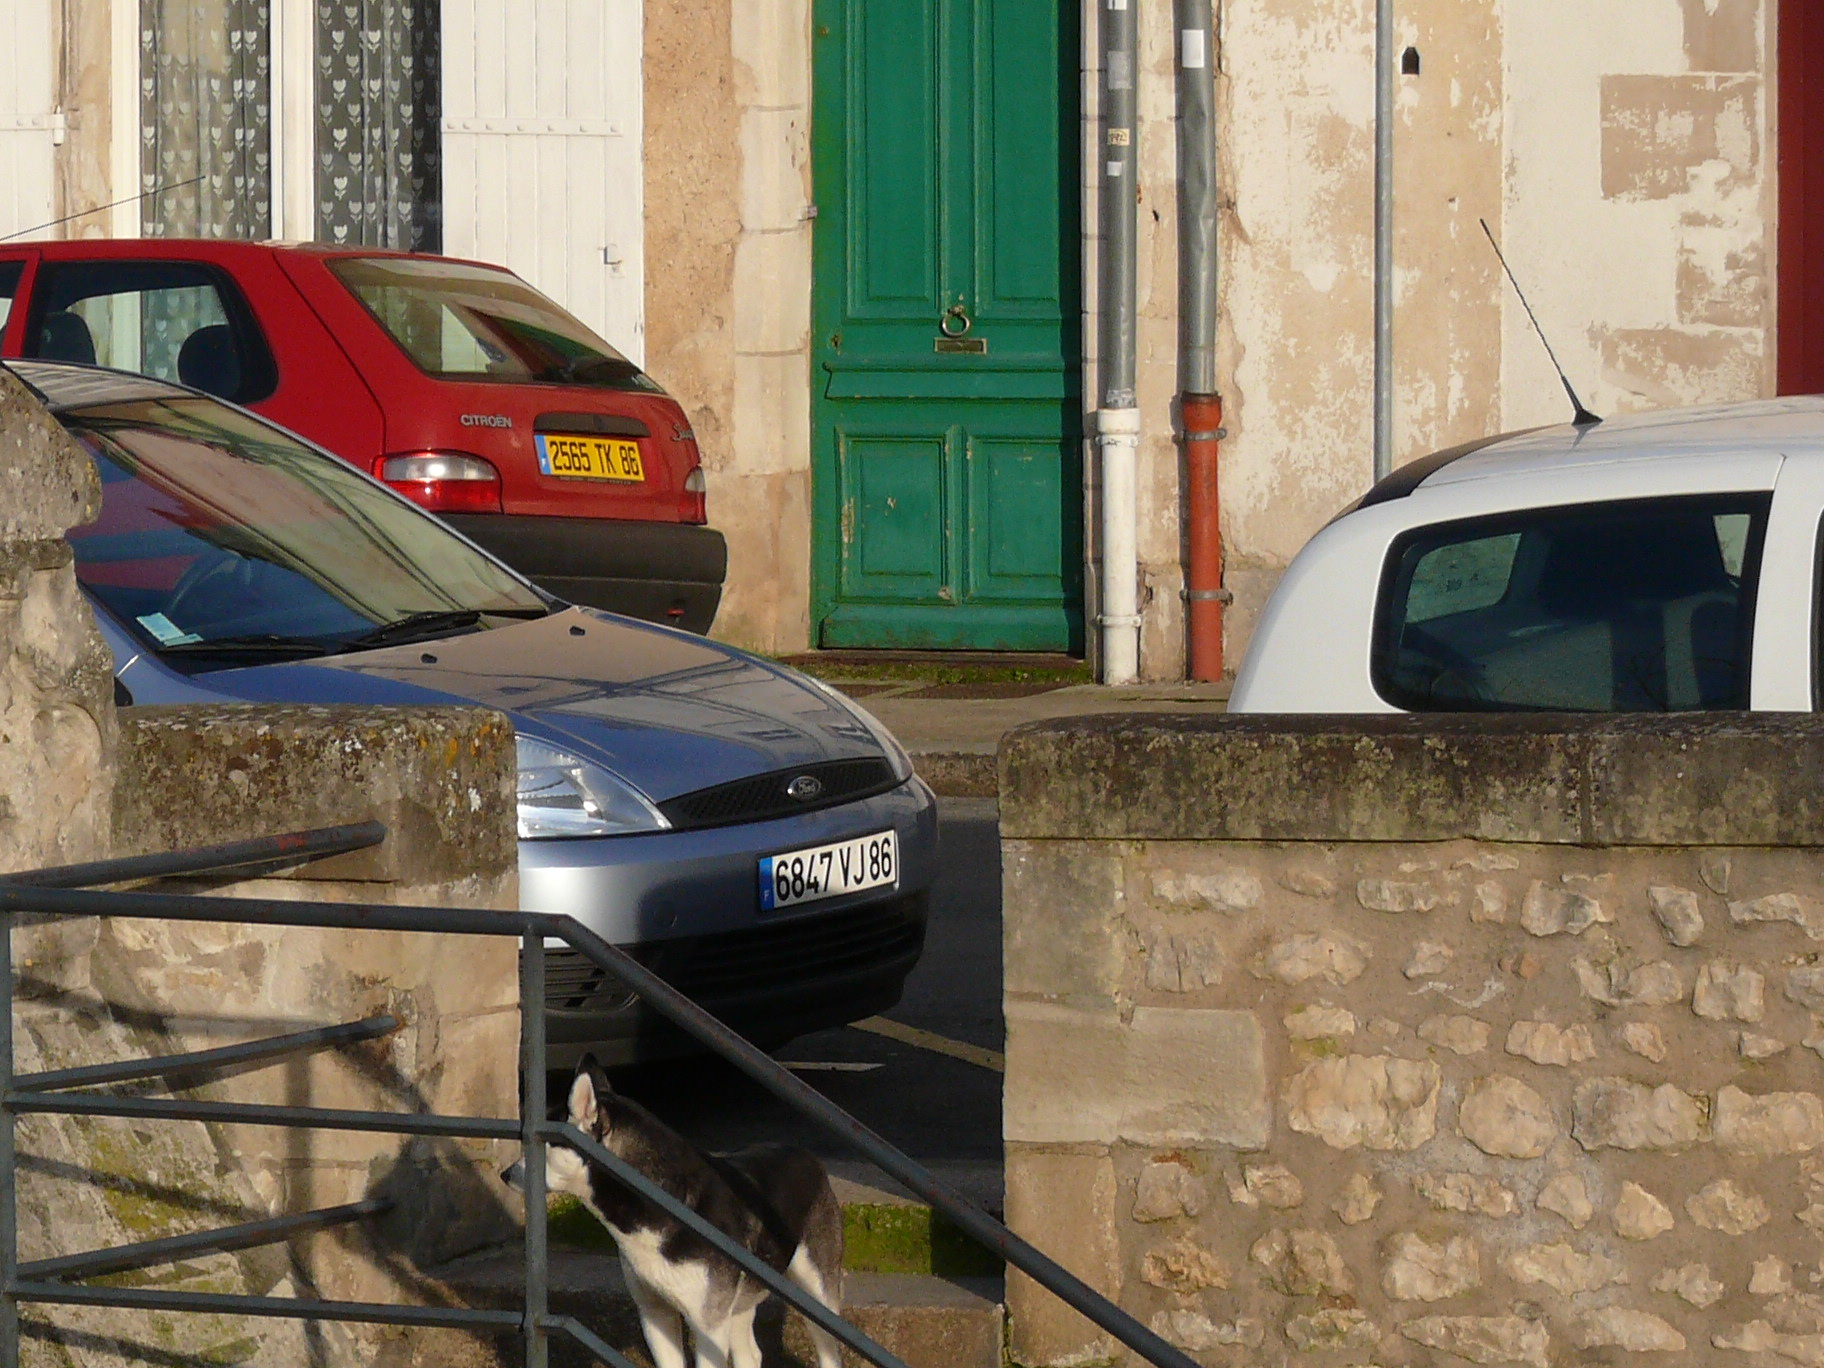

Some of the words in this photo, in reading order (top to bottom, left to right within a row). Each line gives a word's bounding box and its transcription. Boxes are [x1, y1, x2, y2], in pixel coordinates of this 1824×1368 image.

[460, 413, 512, 428] CITROËN
[549, 440, 591, 472] 2565
[594, 443, 617, 474] TK
[619, 445, 640, 476] 86
[776, 850, 833, 901] 6847
[839, 843, 865, 888] VJ
[869, 837, 892, 881] 86
